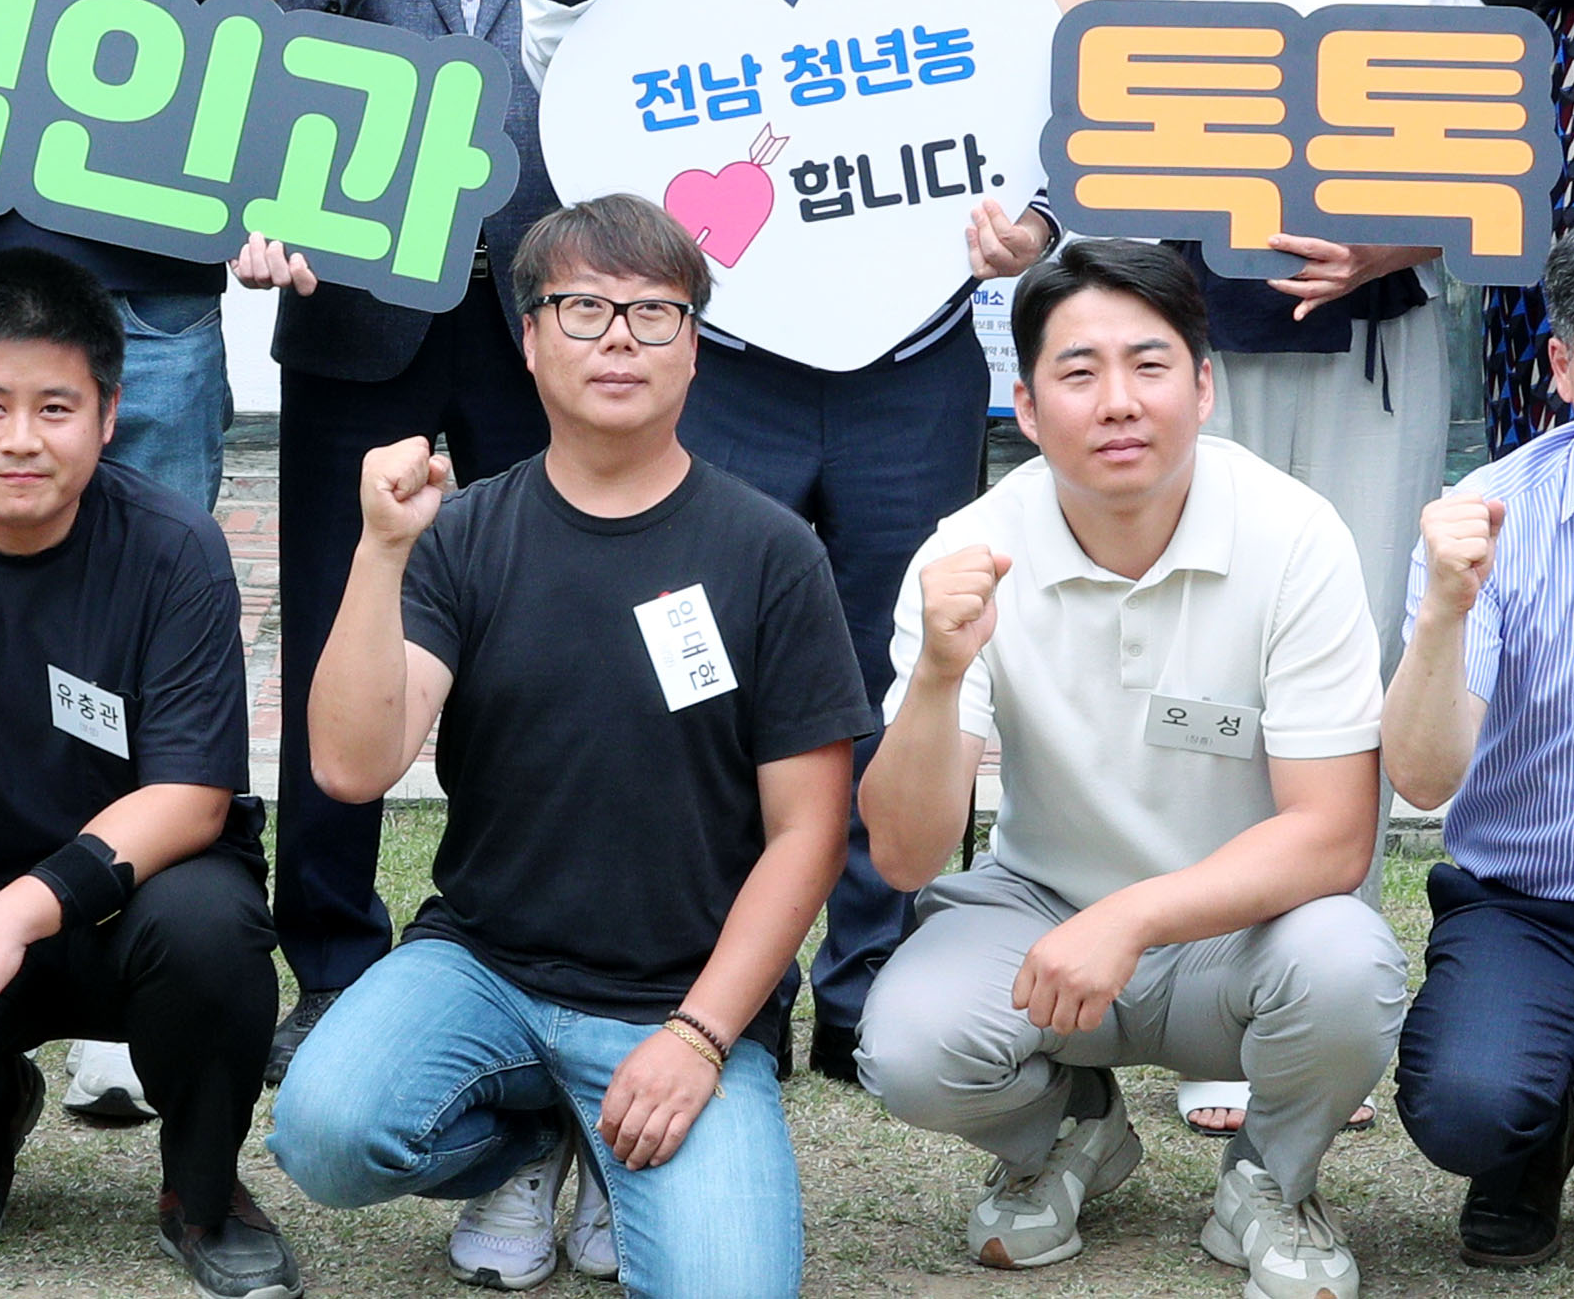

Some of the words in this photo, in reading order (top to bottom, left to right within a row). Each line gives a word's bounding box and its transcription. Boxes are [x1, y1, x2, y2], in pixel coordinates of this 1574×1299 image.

[632, 54, 763, 133] 전남
[783, 24, 978, 108] 청년농
[788, 132, 1006, 224] 합니다.
[1066, 25, 1535, 257] 톡톡
[667, 600, 721, 691] 임대현
[56, 683, 120, 732] 유충관
